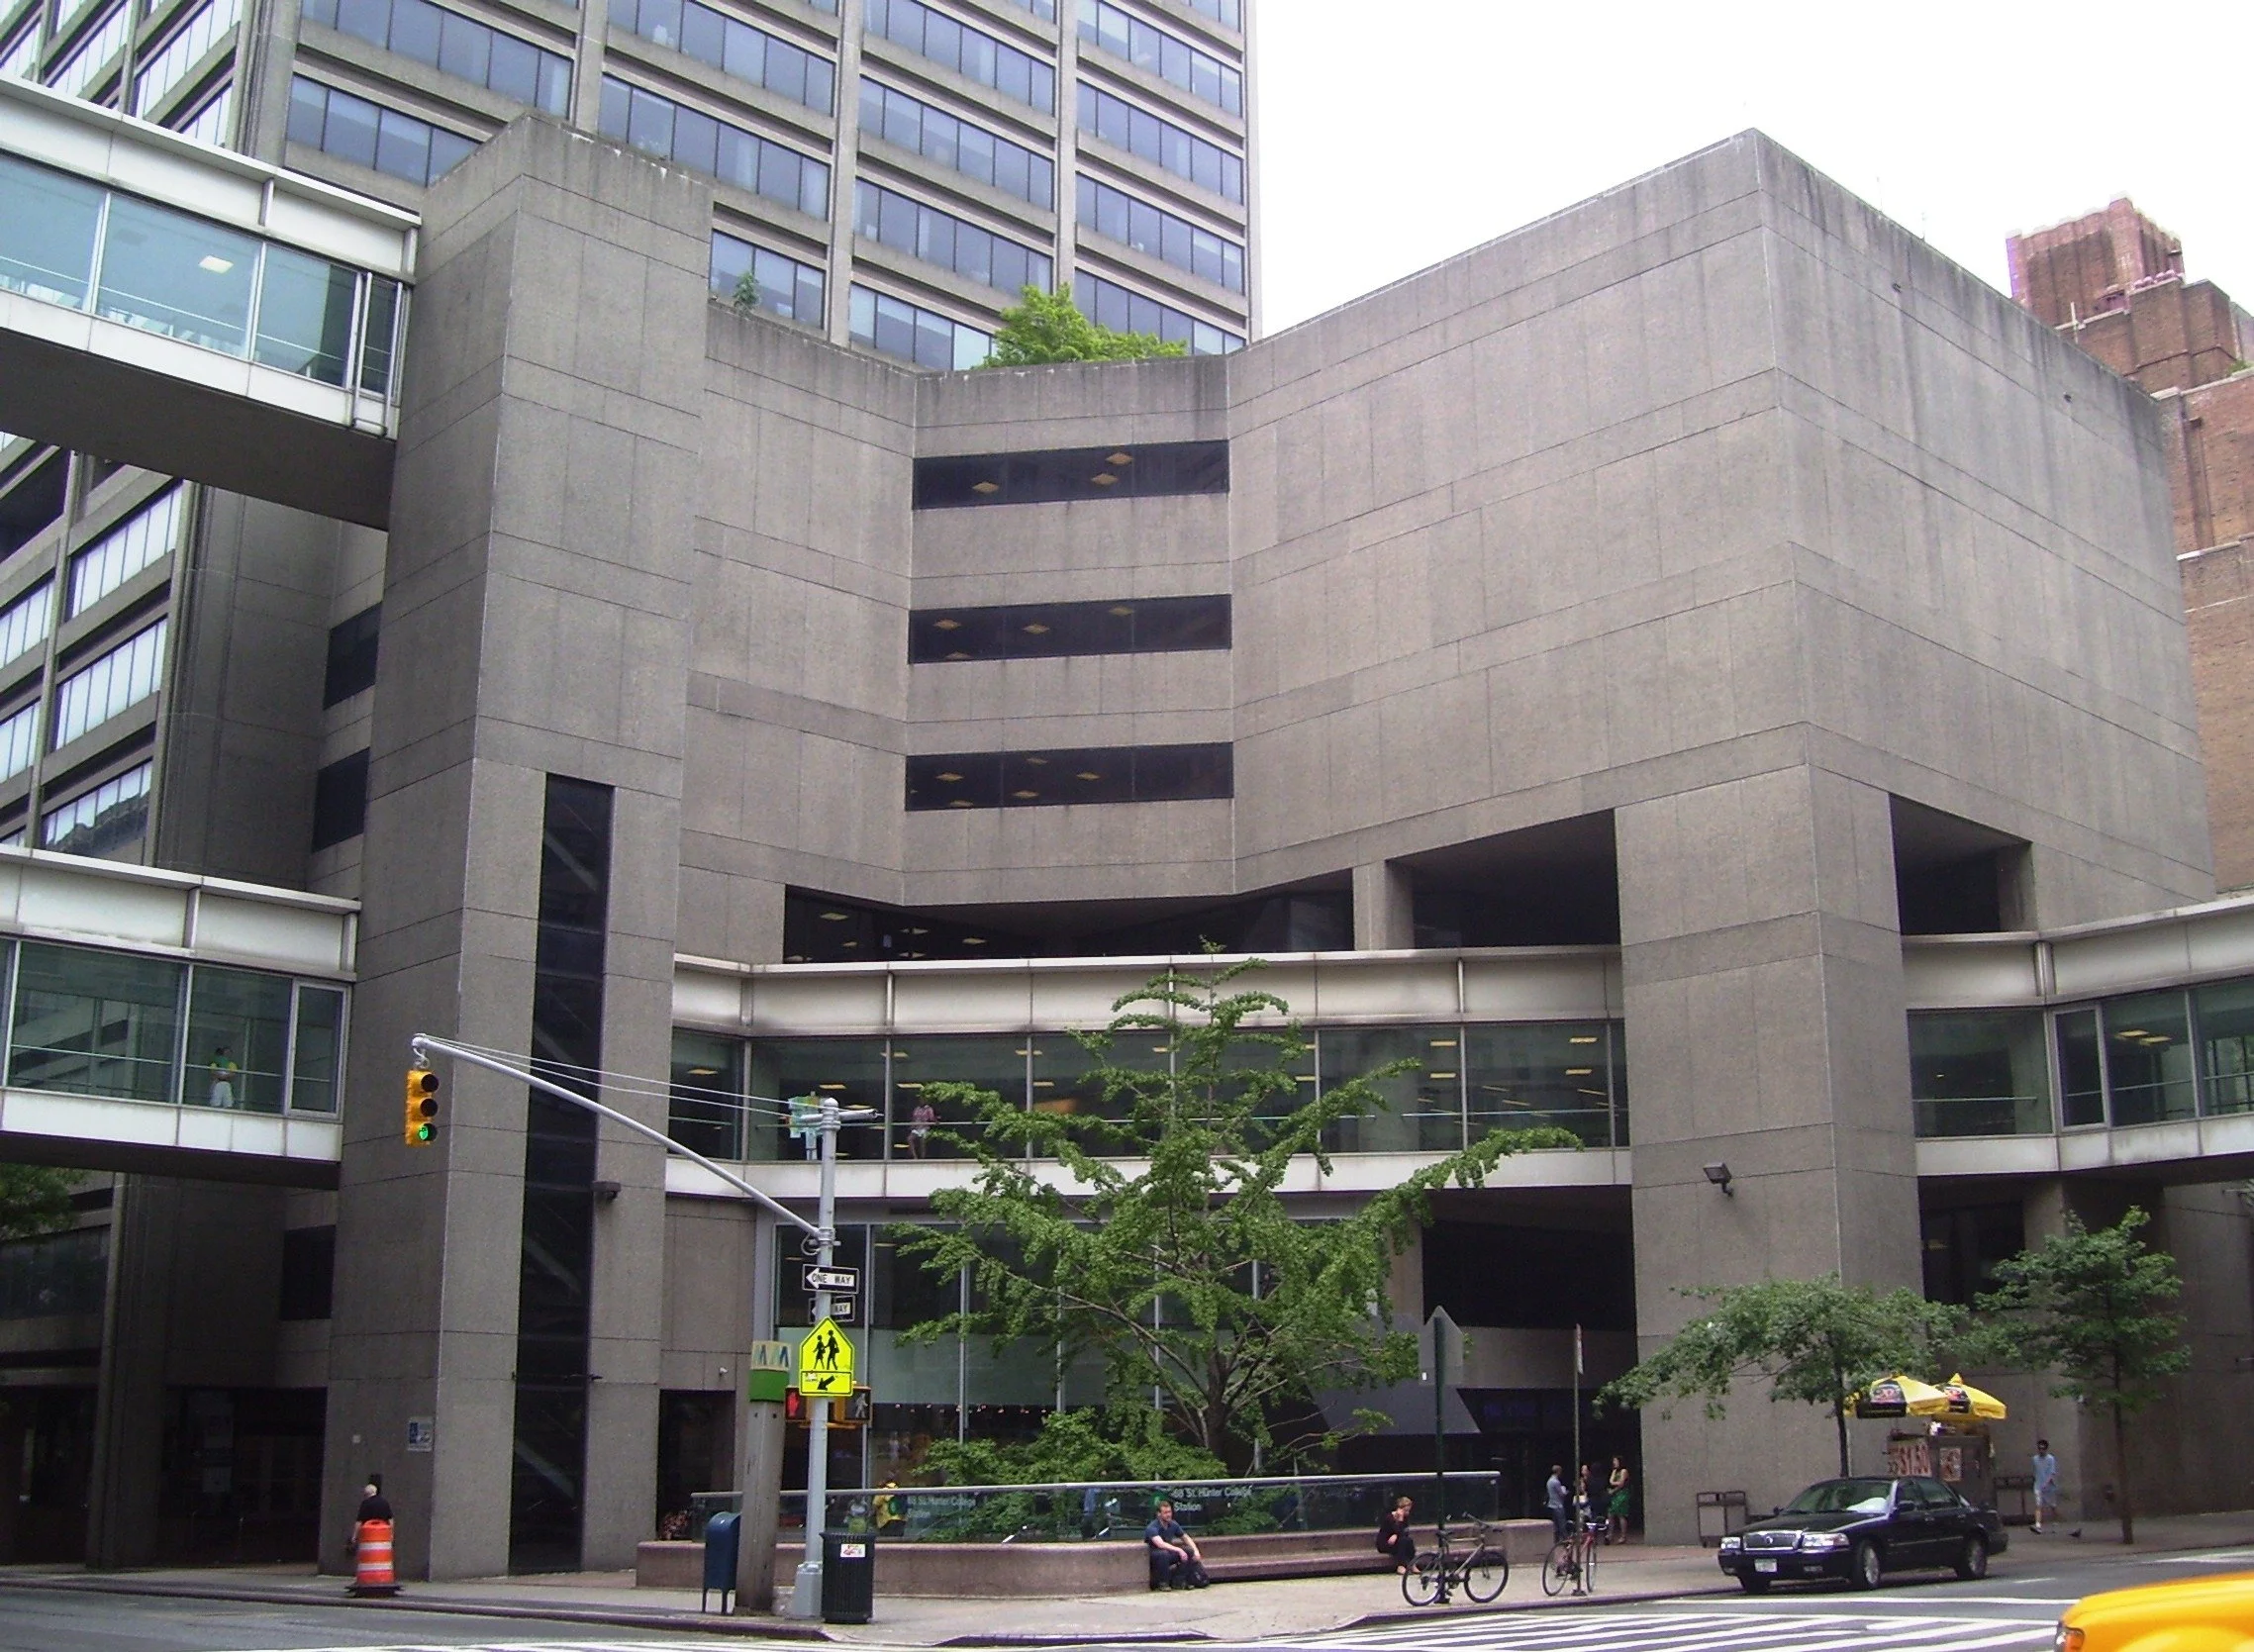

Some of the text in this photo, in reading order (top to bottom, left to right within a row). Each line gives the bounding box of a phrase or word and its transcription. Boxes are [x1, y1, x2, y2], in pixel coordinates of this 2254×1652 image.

[812, 1273, 851, 1285] ONE WAY
[1173, 1502, 1202, 1511] Station
